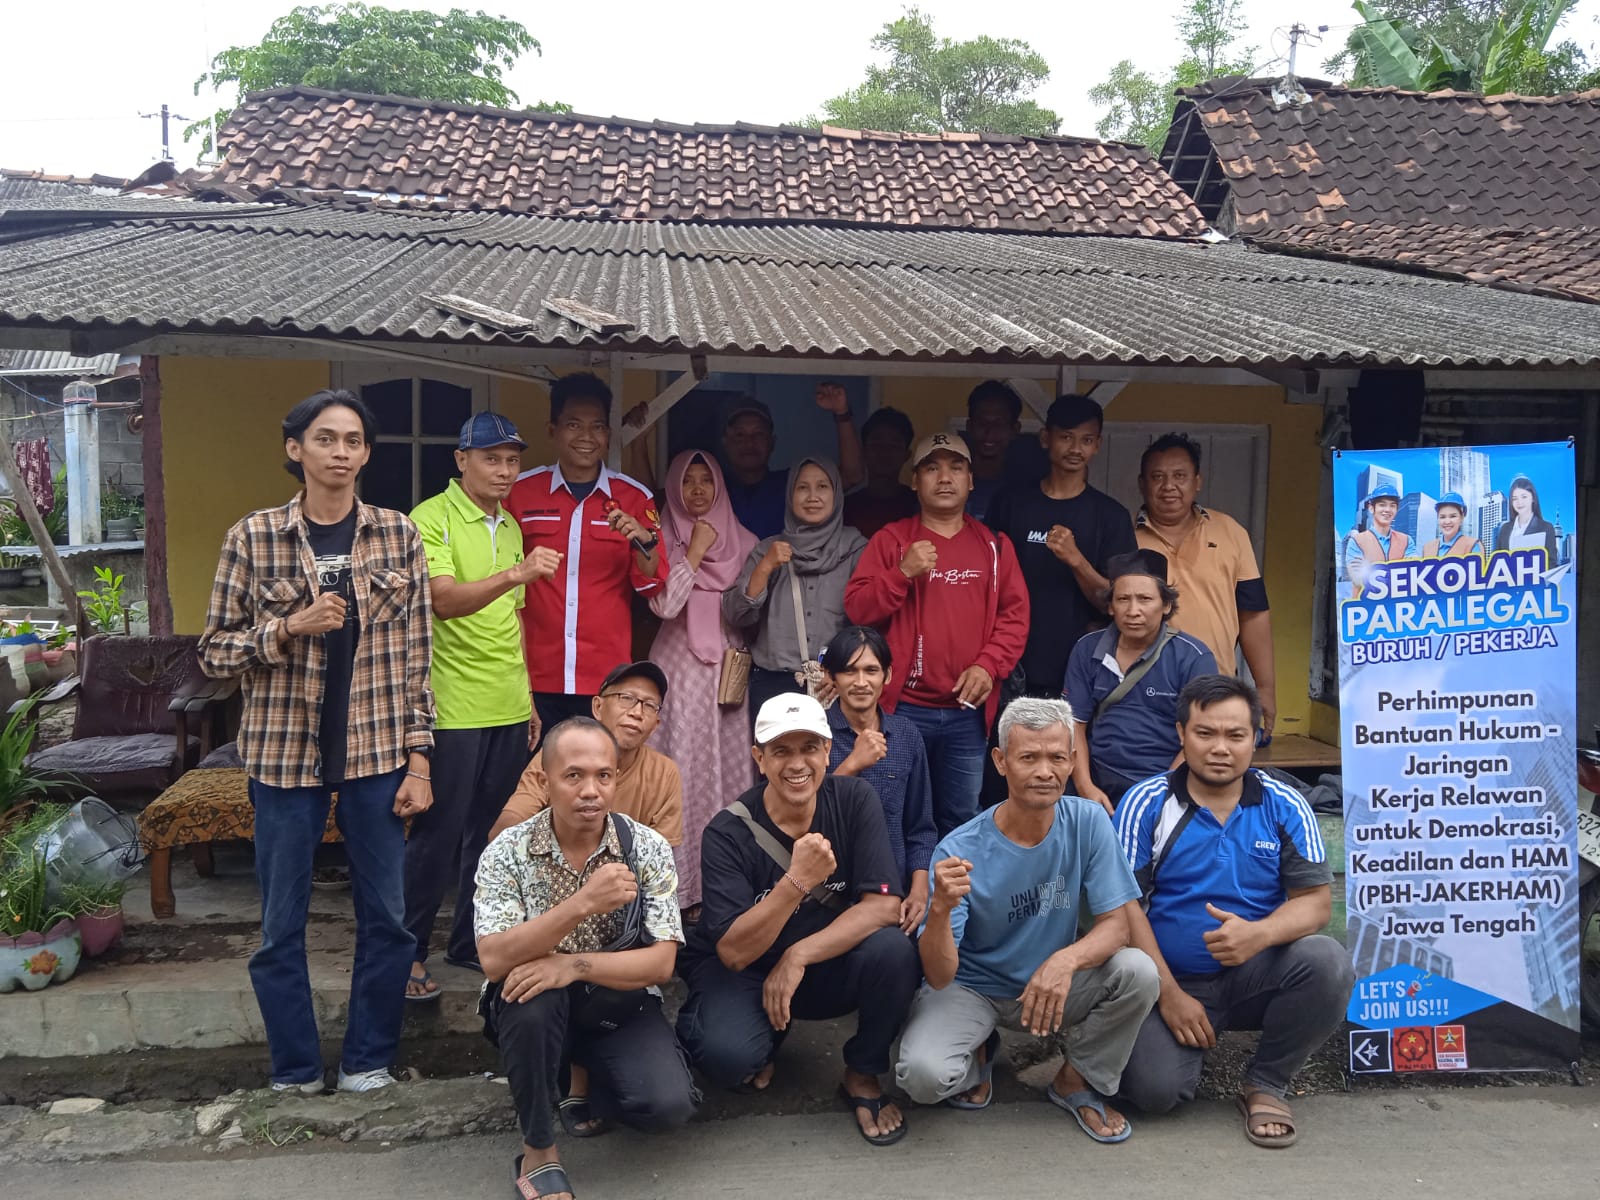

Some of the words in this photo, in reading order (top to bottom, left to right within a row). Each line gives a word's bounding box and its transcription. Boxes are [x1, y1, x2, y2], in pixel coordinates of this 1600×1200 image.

[929, 568, 943, 582] The
[1367, 555, 1540, 600] SEKOLAH
[1347, 588, 1563, 636] PARALEGAL
[1352, 638, 1430, 664] BURUH
[1436, 634, 1449, 660] /
[1455, 627, 1557, 655] PEKERJA
[1378, 690, 1533, 714] Perhimpunan
[1355, 725, 1452, 745] Bantuan
[1459, 720, 1541, 741] Hukum
[1405, 755, 1508, 778] Jaringan
[1372, 788, 1434, 812] Kerja
[1441, 785, 1542, 806] Relawan
[1356, 820, 1422, 841] untuk
[1429, 816, 1561, 839] Demokrasi,
[1353, 851, 1453, 873] Keadilan
[1460, 849, 1504, 870] dan
[1512, 848, 1568, 868] HAM
[1359, 879, 1561, 910] (PBH-JAKERHAM)
[1383, 917, 1445, 936] Jawa
[1450, 912, 1536, 938] Tengah
[1360, 980, 1406, 999] LET'S
[1360, 1001, 1400, 1020] JOIN
[1406, 999, 1449, 1017] US!!!
